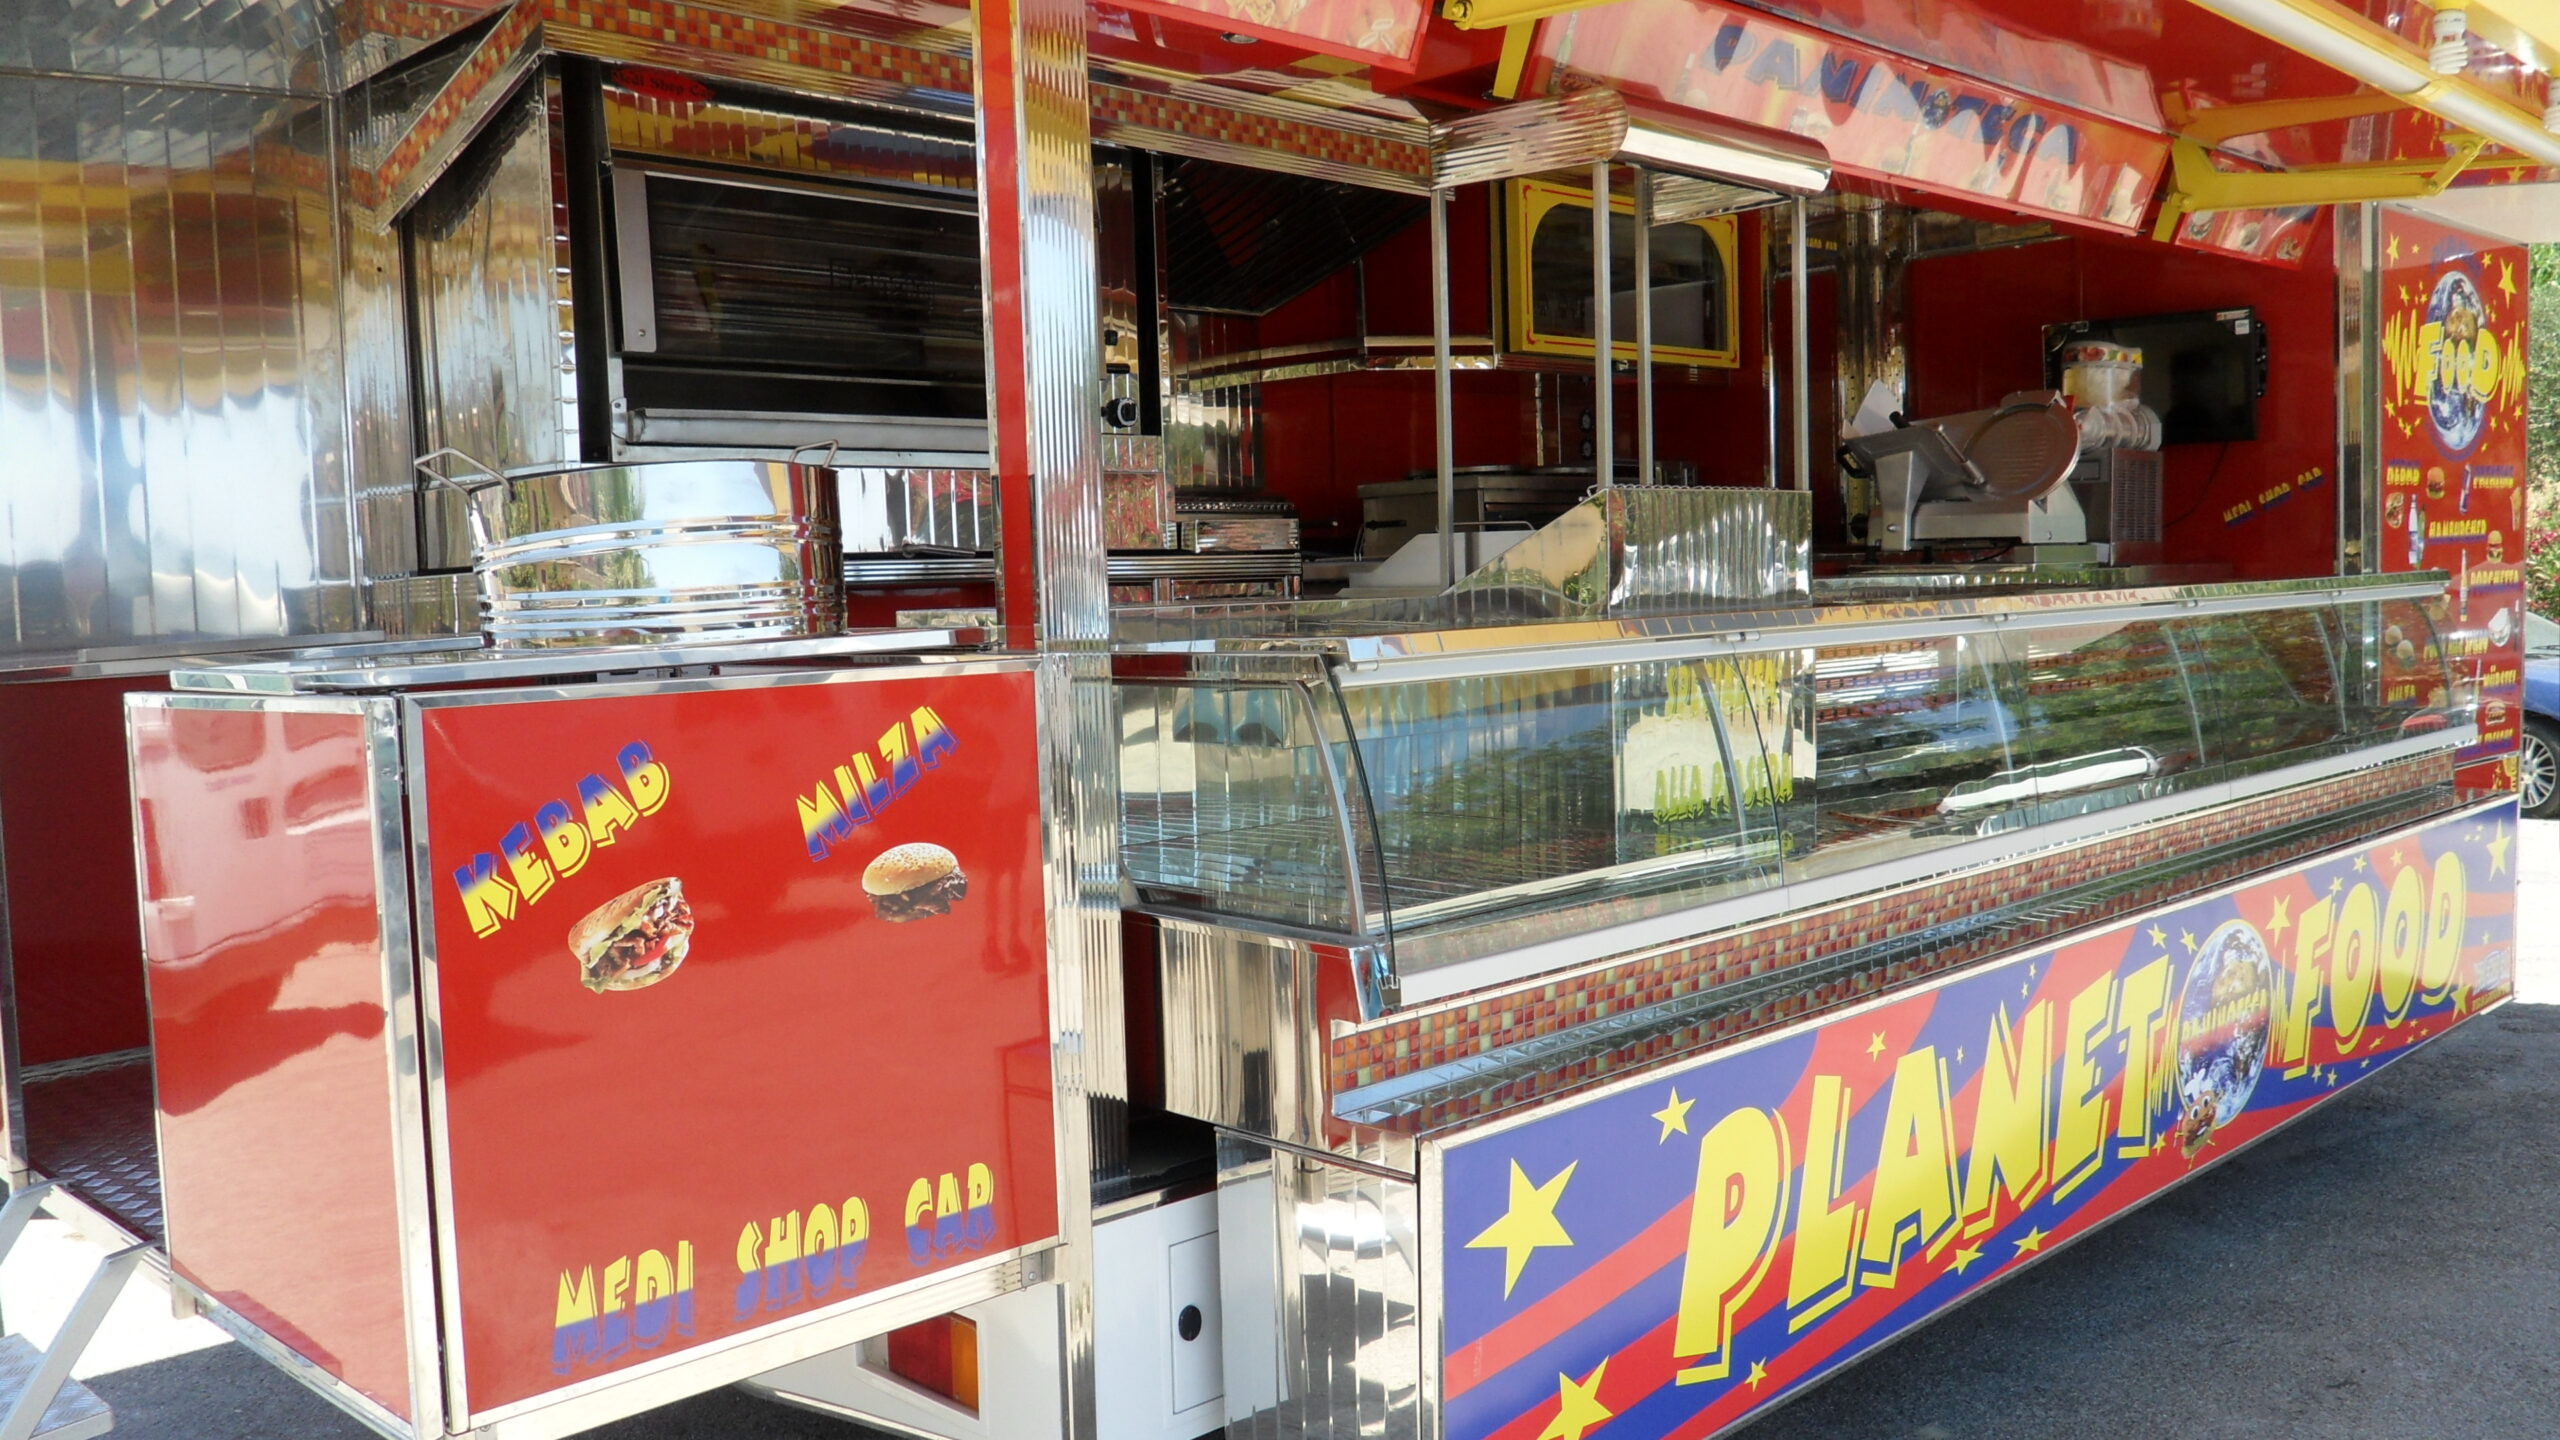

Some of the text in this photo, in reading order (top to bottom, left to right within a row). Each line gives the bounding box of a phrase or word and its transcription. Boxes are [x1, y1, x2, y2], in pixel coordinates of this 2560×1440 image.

[2415, 321, 2502, 407] FOOD
[454, 740, 670, 939] KEBAB
[796, 706, 959, 862] MILZA
[1673, 851, 2467, 1386] PLANET FOOD
[551, 1162, 997, 1376] MEDI SHOP CAR
